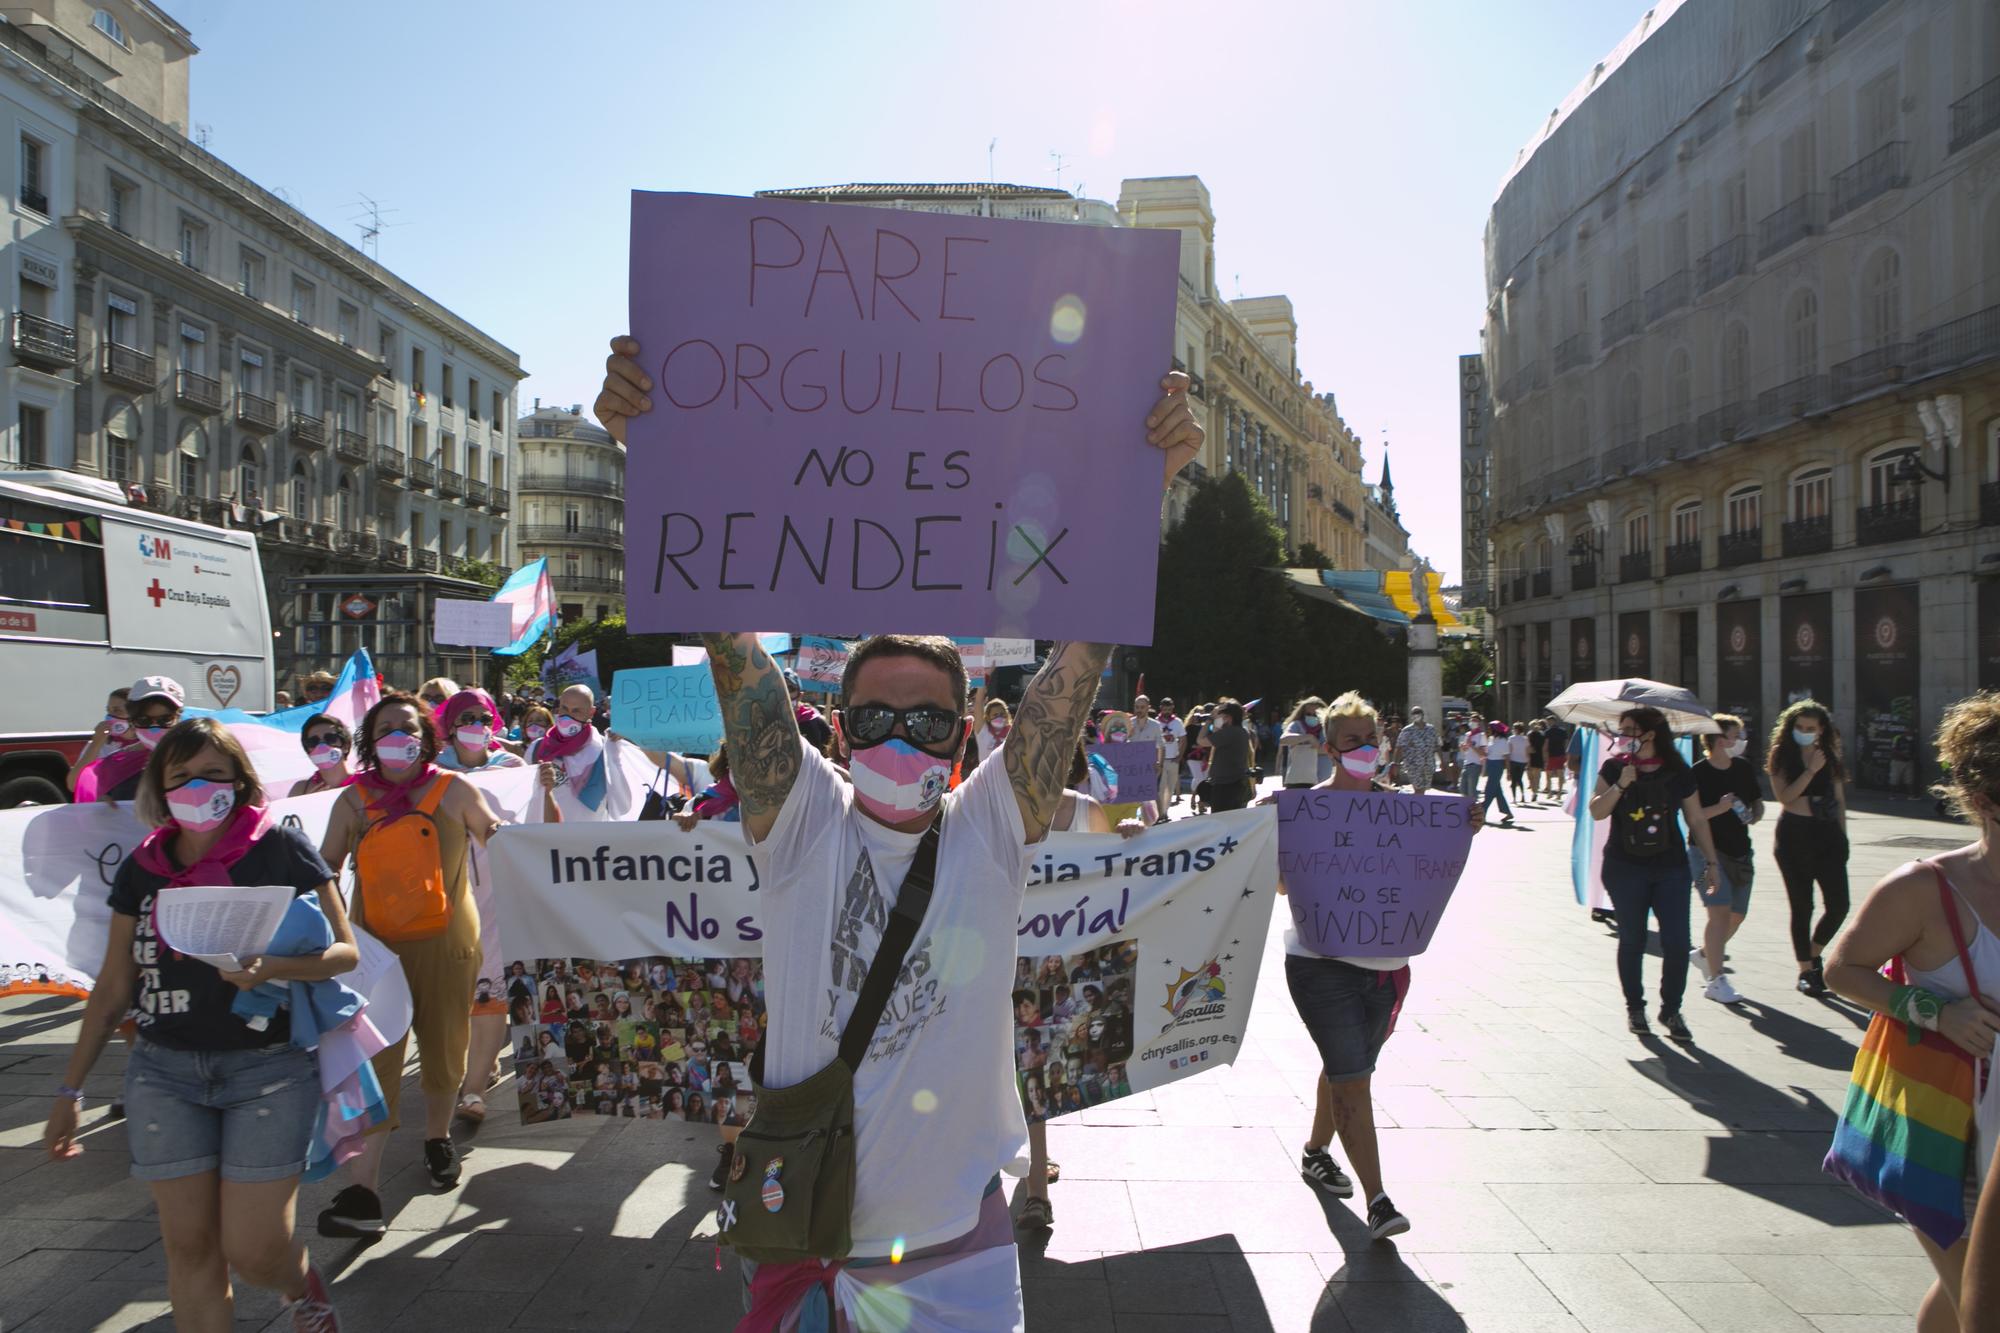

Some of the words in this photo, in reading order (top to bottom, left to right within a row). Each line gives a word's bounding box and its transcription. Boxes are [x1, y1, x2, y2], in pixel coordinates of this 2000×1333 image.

[749, 215, 989, 322] PARE
[662, 338, 1079, 415] ORGULLOS
[1463, 357, 1482, 448] HOTEL
[793, 445, 875, 488] NO
[904, 450, 972, 491] ES
[1463, 459, 1484, 585] MODERNO
[168, 588, 185, 602] Cruz
[185, 590, 201, 607] Roja
[632, 700, 714, 728] TRANS
[1345, 798, 1462, 829] MADRES
[1335, 831, 1354, 848] DE
[1376, 832, 1402, 848] LA
[550, 844, 732, 884] Infancia
[1337, 885, 1365, 902] NO
[1376, 887, 1401, 904] SE
[666, 892, 720, 941] No
[1141, 1033, 1238, 1061] chrysallis.org.es
